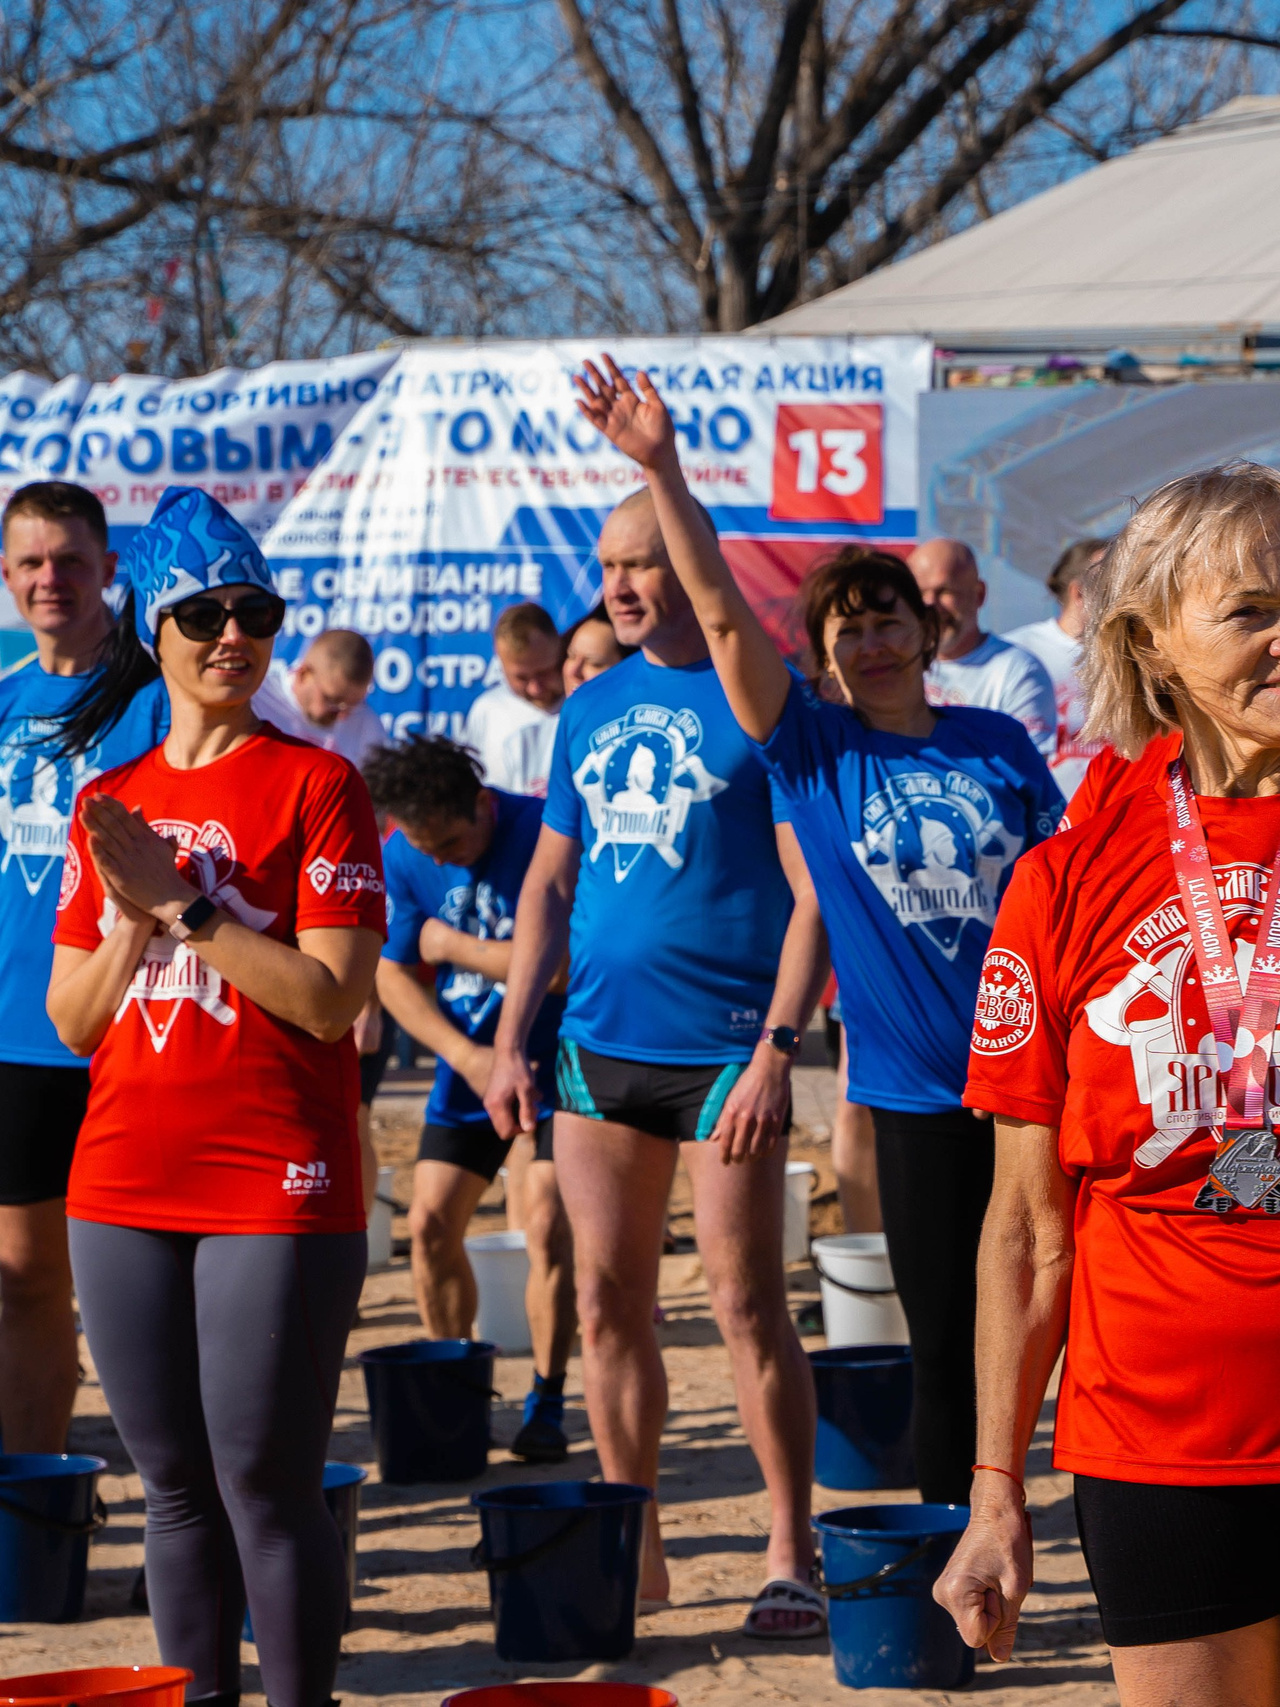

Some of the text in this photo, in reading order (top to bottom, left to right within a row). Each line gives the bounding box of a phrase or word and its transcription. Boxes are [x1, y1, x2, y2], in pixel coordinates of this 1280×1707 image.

[754, 366, 883, 394] АКЦИЯ
[512, 405, 751, 455] МОНО
[788, 429, 868, 496] 13
[311, 562, 543, 601] ОБЛИВАНИЕ
[359, 595, 491, 637] ВОДОЙ
[337, 862, 377, 879] ПУТЬ
[1194, 908, 1223, 959] МОРЖИ
[281, 1179, 331, 1190] SPORT
